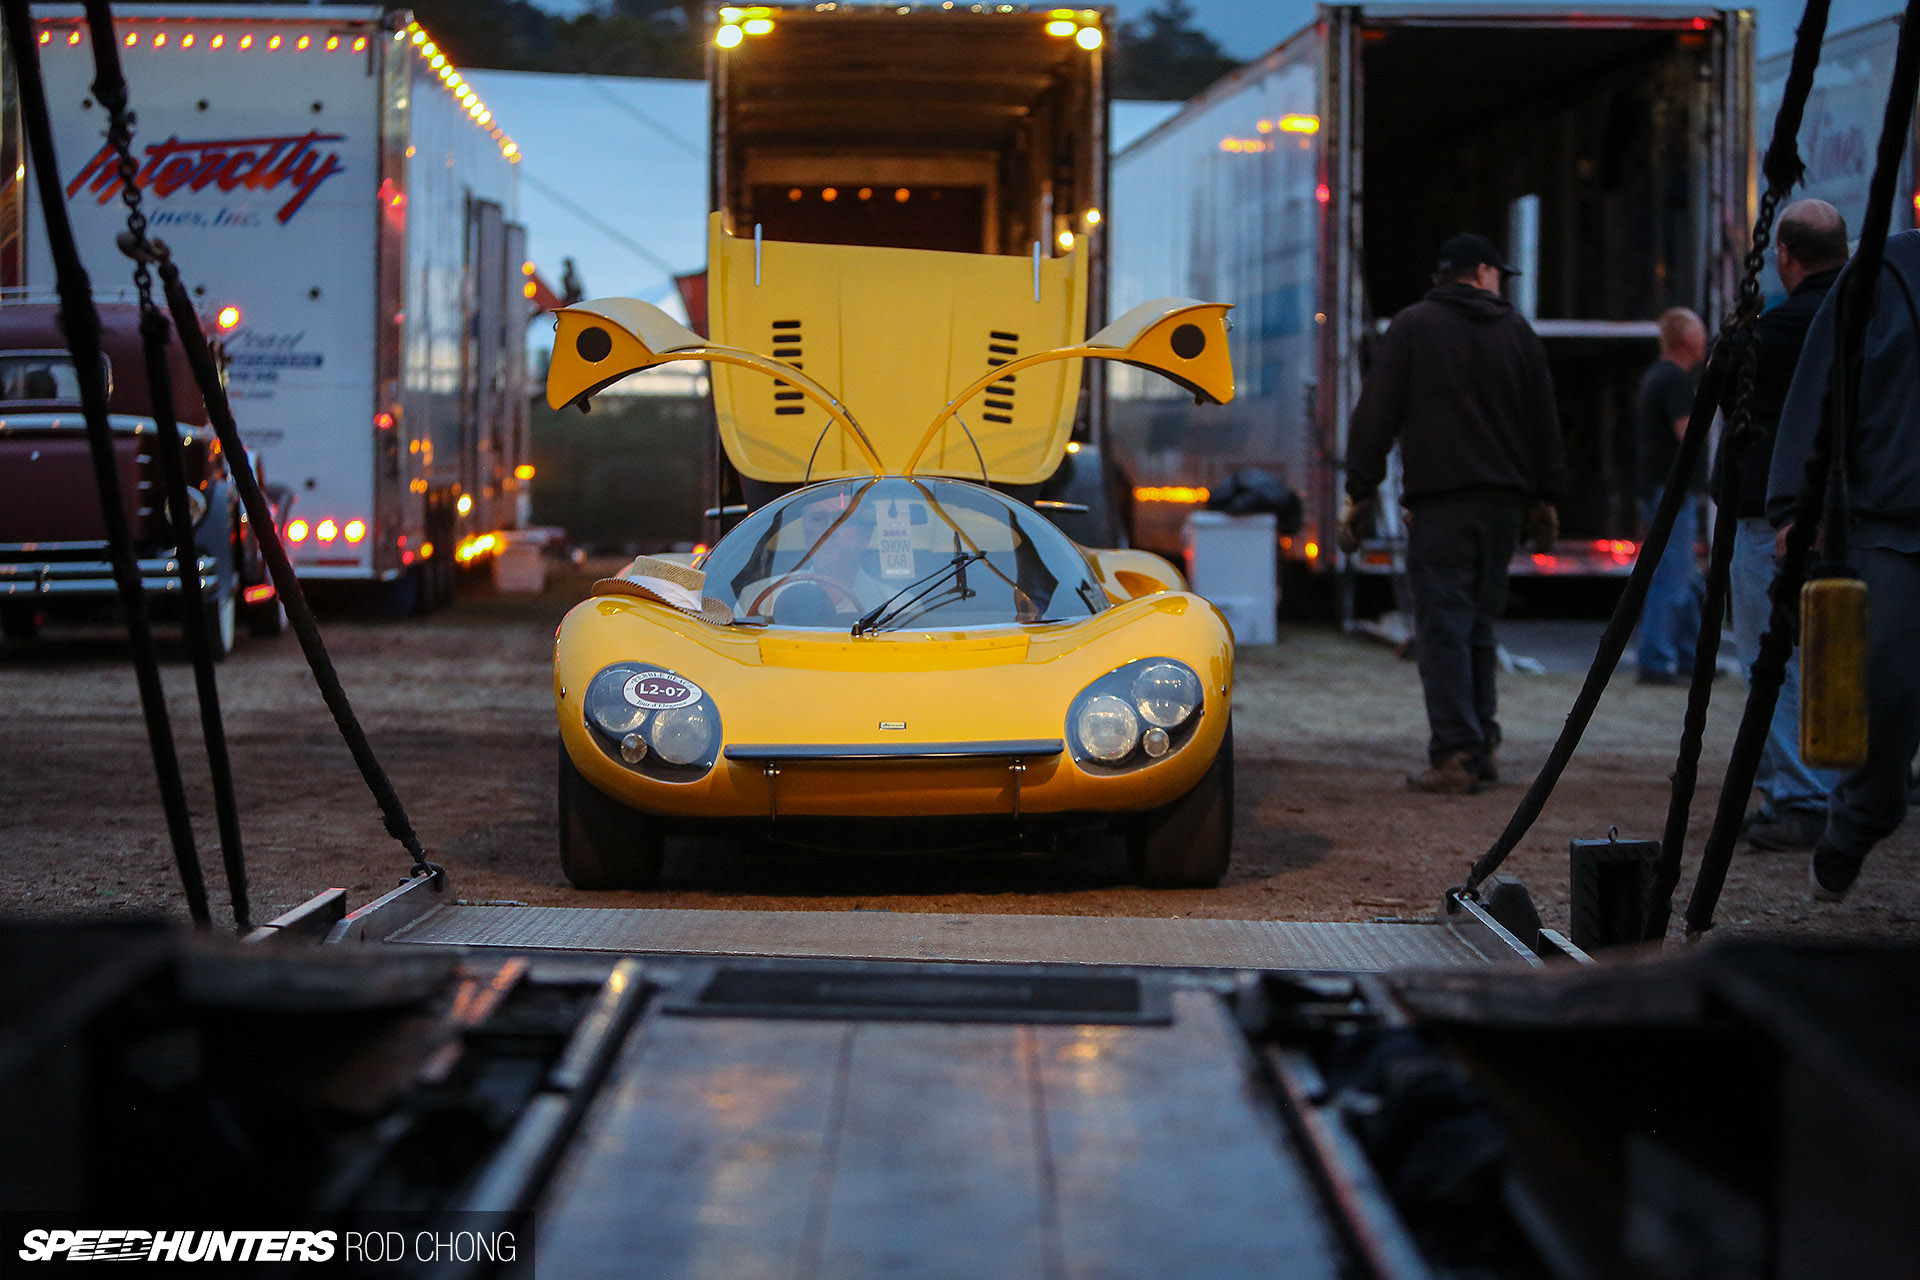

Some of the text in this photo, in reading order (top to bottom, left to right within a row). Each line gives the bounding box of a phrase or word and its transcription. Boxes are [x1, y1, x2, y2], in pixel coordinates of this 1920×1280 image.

[66, 130, 345, 225] Intercity
[148, 207, 208, 228] ines,
[881, 540, 910, 553] SHOW
[887, 554, 907, 567] CAR
[633, 672, 695, 689] PEBBLE BEACH
[640, 683, 686, 697] L2-07
